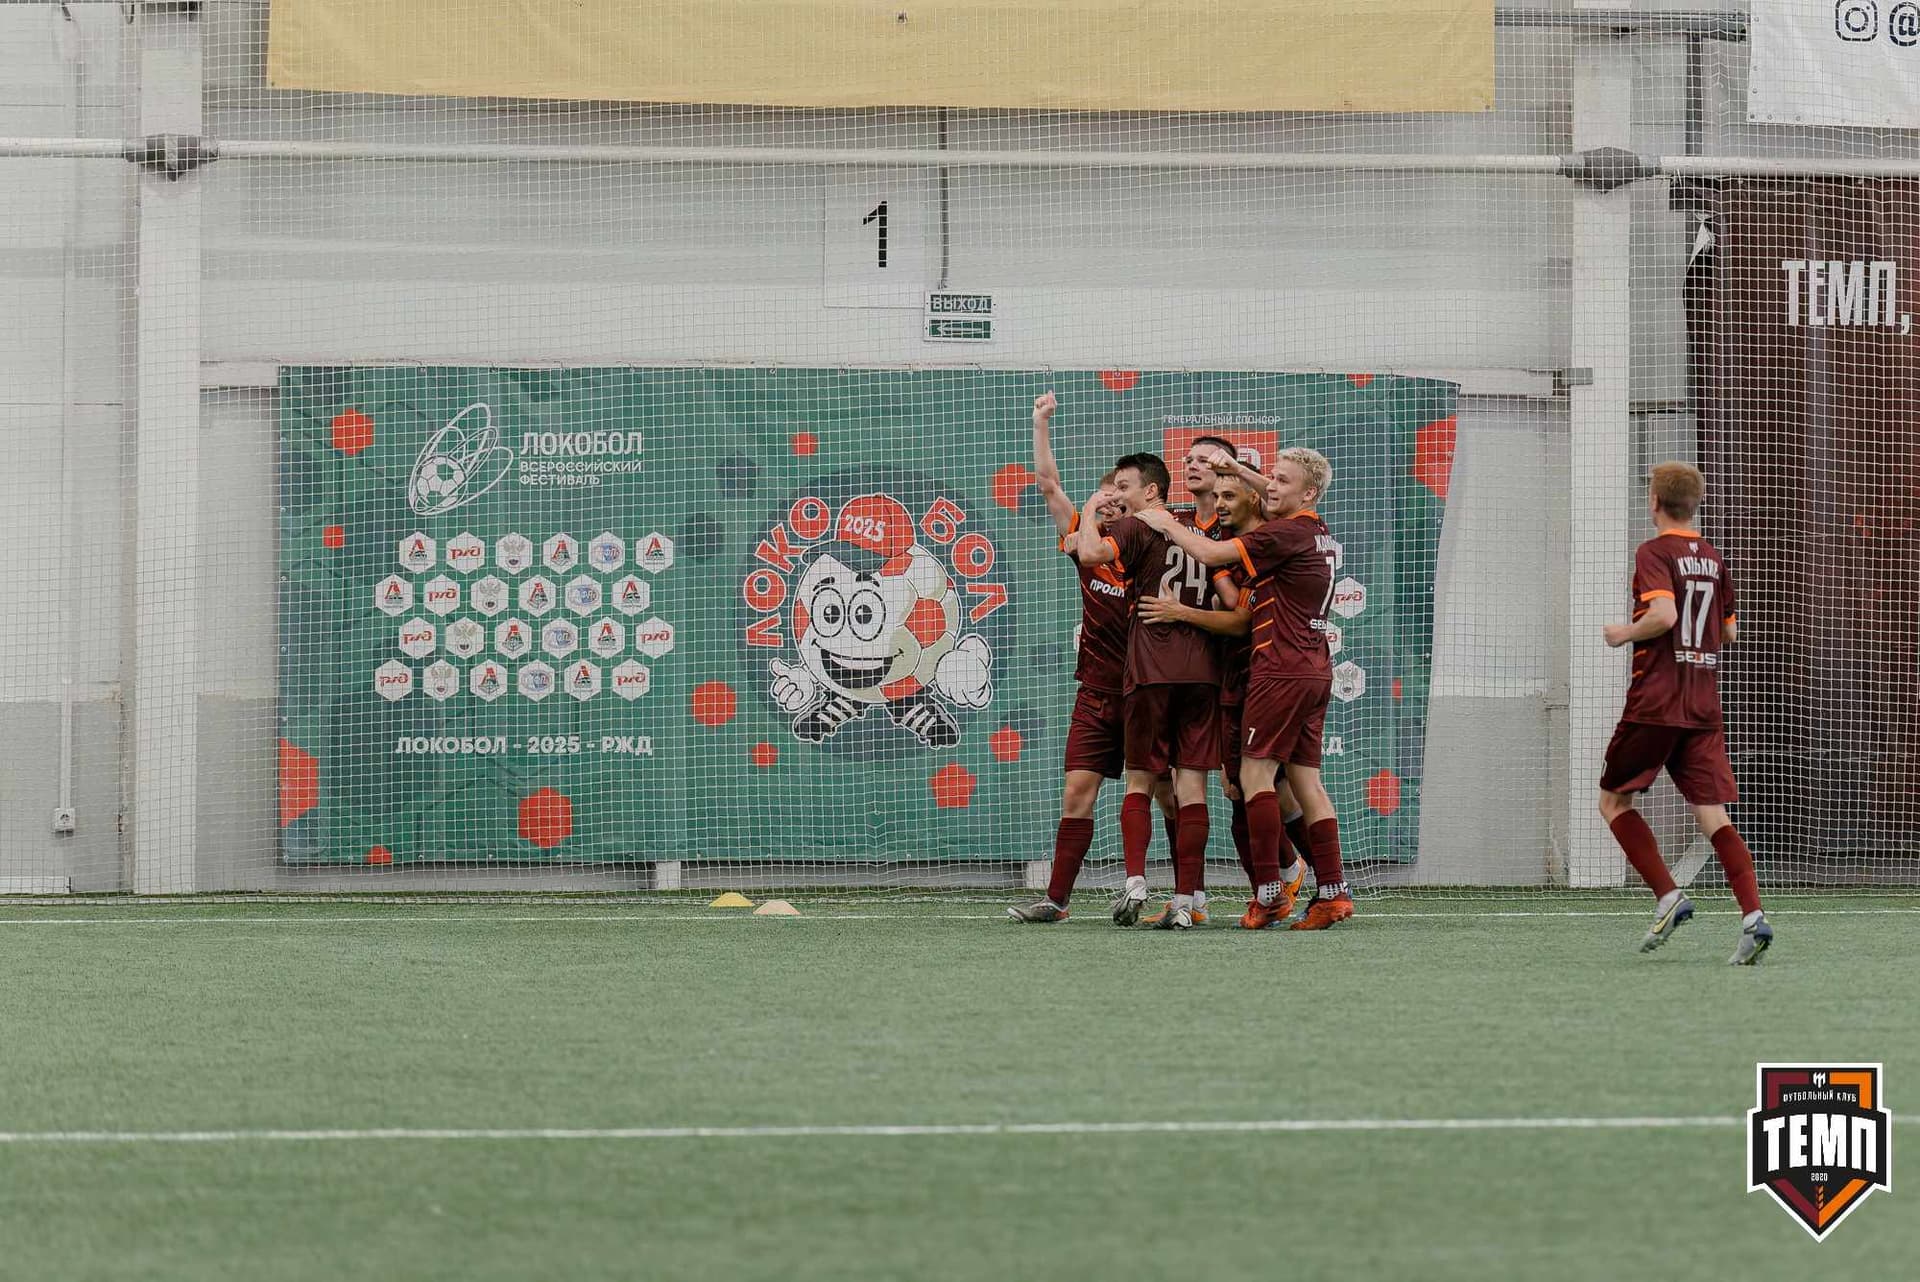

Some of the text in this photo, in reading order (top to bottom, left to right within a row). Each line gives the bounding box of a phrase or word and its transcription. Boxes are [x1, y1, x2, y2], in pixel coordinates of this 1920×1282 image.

[863, 200, 888, 268] 1
[931, 295, 990, 311] ВЫХОД
[1782, 260, 1910, 335] ТЕМП,
[1162, 414, 1281, 425] ГЕНЕРАЛЬНЫЙ СПОНСОР
[520, 431, 643, 456] ЛОКОБОЛ
[520, 459, 643, 473] ВСЕРОССИЙСКИЙ
[519, 473, 600, 486] ФЕСТИВАЛЬ
[844, 513, 886, 543] 2025
[1158, 545, 1207, 606] 24
[1681, 580, 1714, 649] 17
[1674, 650, 1717, 665] SEUS
[395, 735, 507, 755] ЛОКОБОЛ
[527, 735, 581, 754] 2025
[602, 735, 653, 757] РЖД
[1247, 727, 1256, 745] 7
